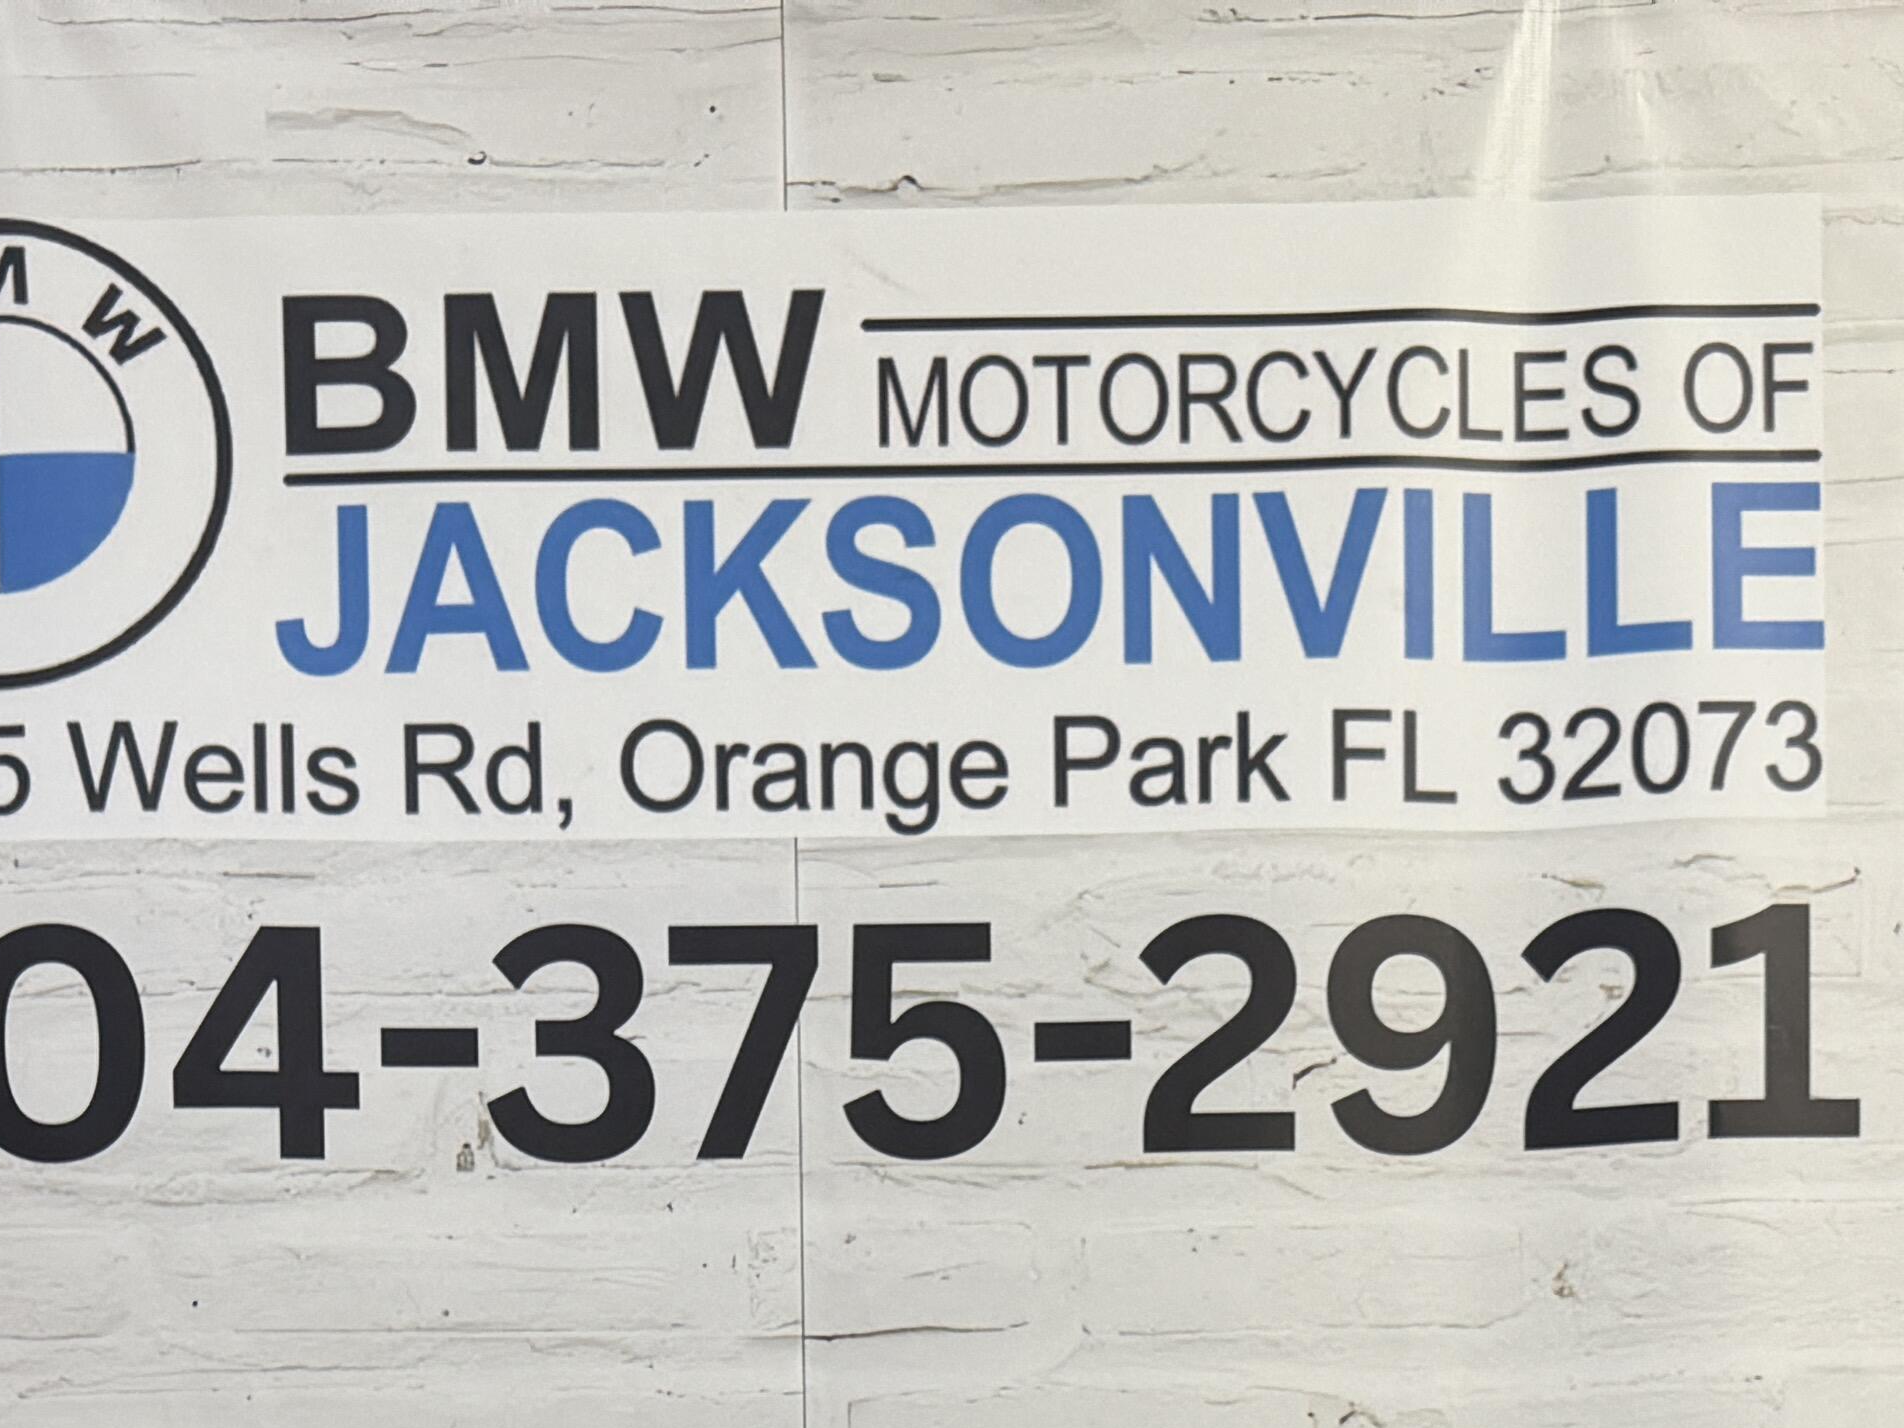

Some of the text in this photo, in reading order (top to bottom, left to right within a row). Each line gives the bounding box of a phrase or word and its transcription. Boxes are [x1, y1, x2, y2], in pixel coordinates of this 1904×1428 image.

[282, 290, 1814, 455] BMW MOTORCYCLES OF
[276, 484, 1824, 676] JACKSONVILLE
[67, 711, 361, 818] Wells
[404, 721, 573, 829] Rd,
[620, 719, 1008, 835] Orange
[1054, 711, 1290, 807] Park
[1333, 709, 1456, 803] FL
[1499, 700, 1823, 804] 32073
